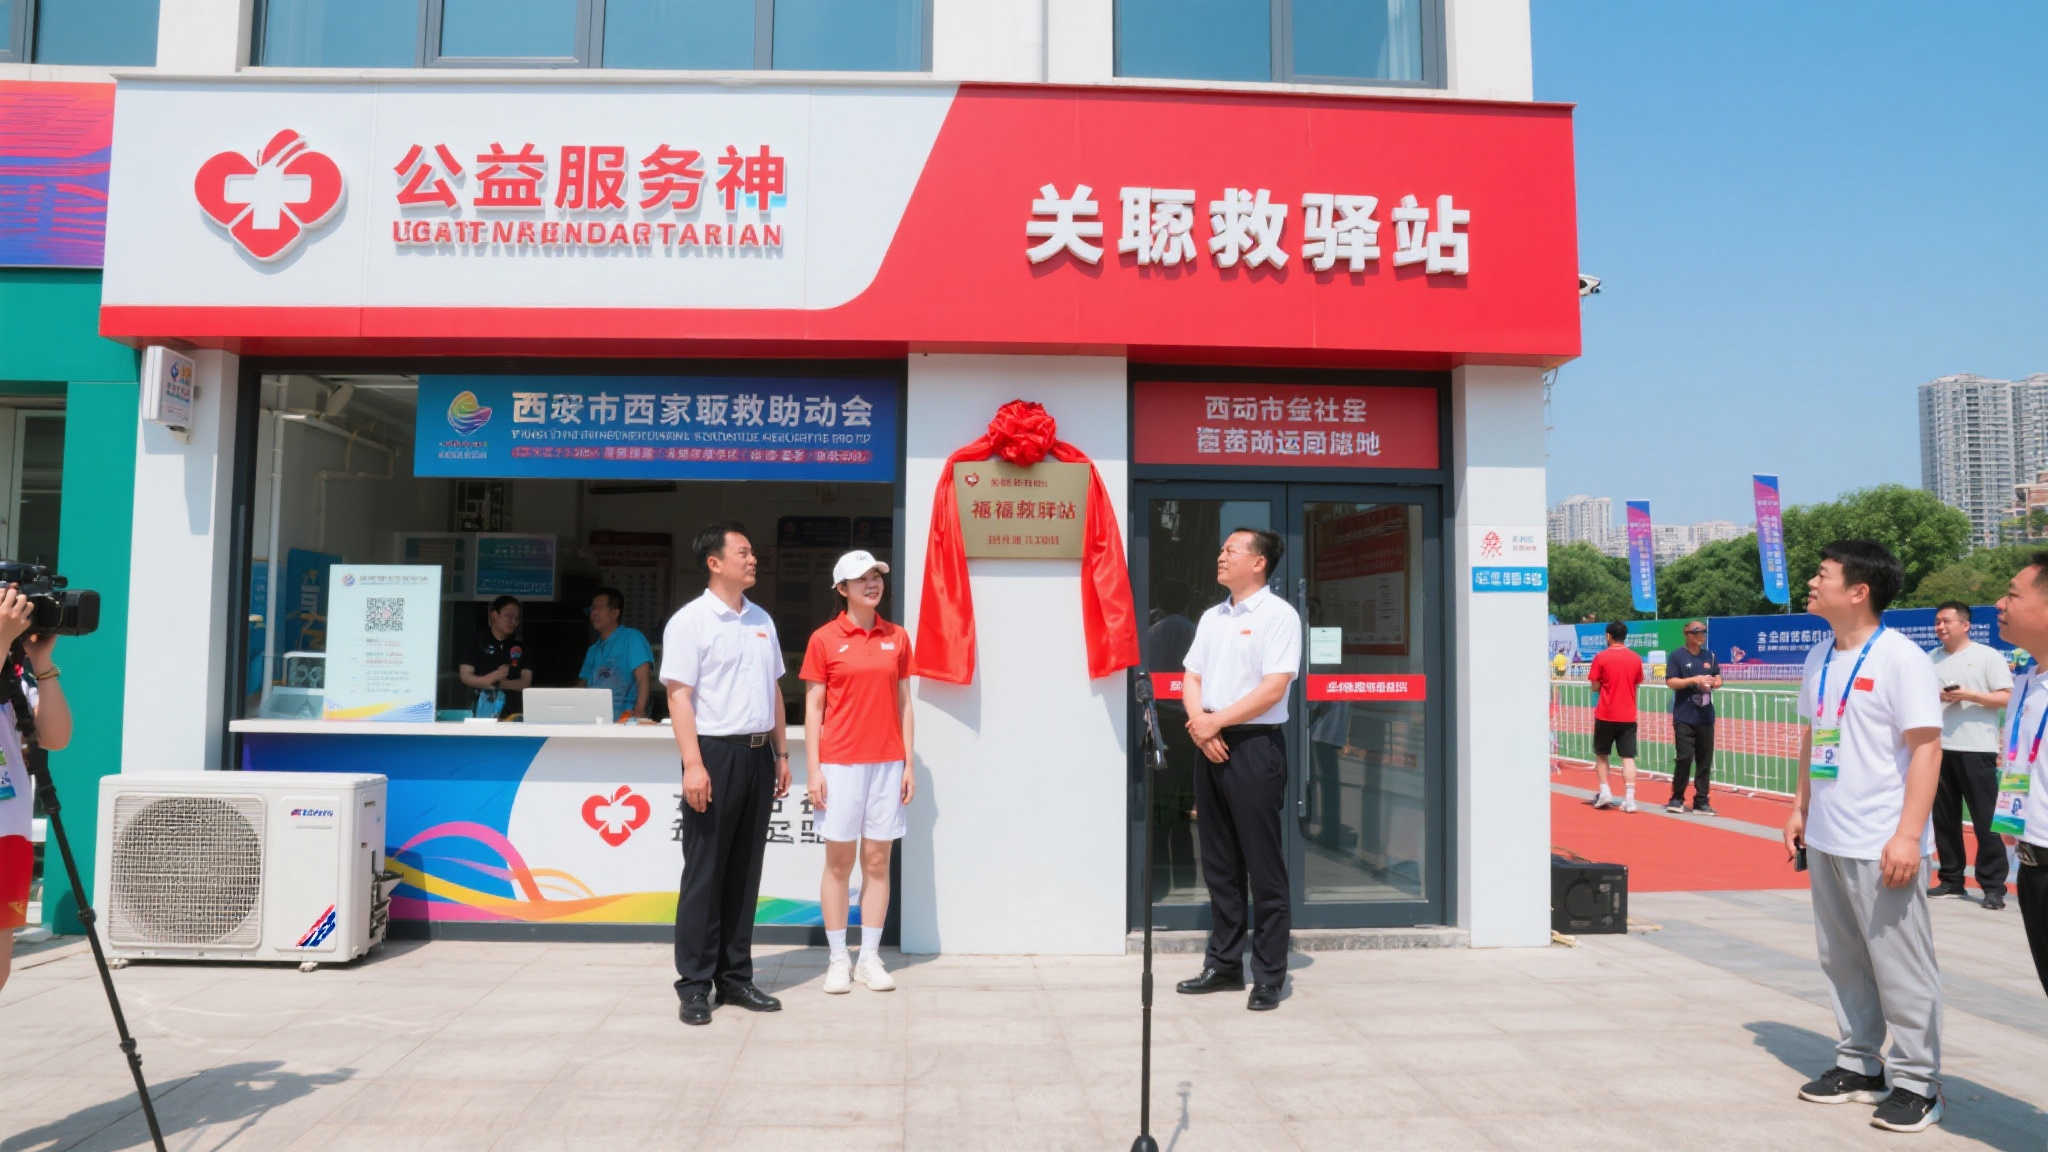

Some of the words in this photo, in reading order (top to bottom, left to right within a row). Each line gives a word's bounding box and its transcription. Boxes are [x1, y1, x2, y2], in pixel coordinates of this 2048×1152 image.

[393, 142, 786, 212] 公益服务神
